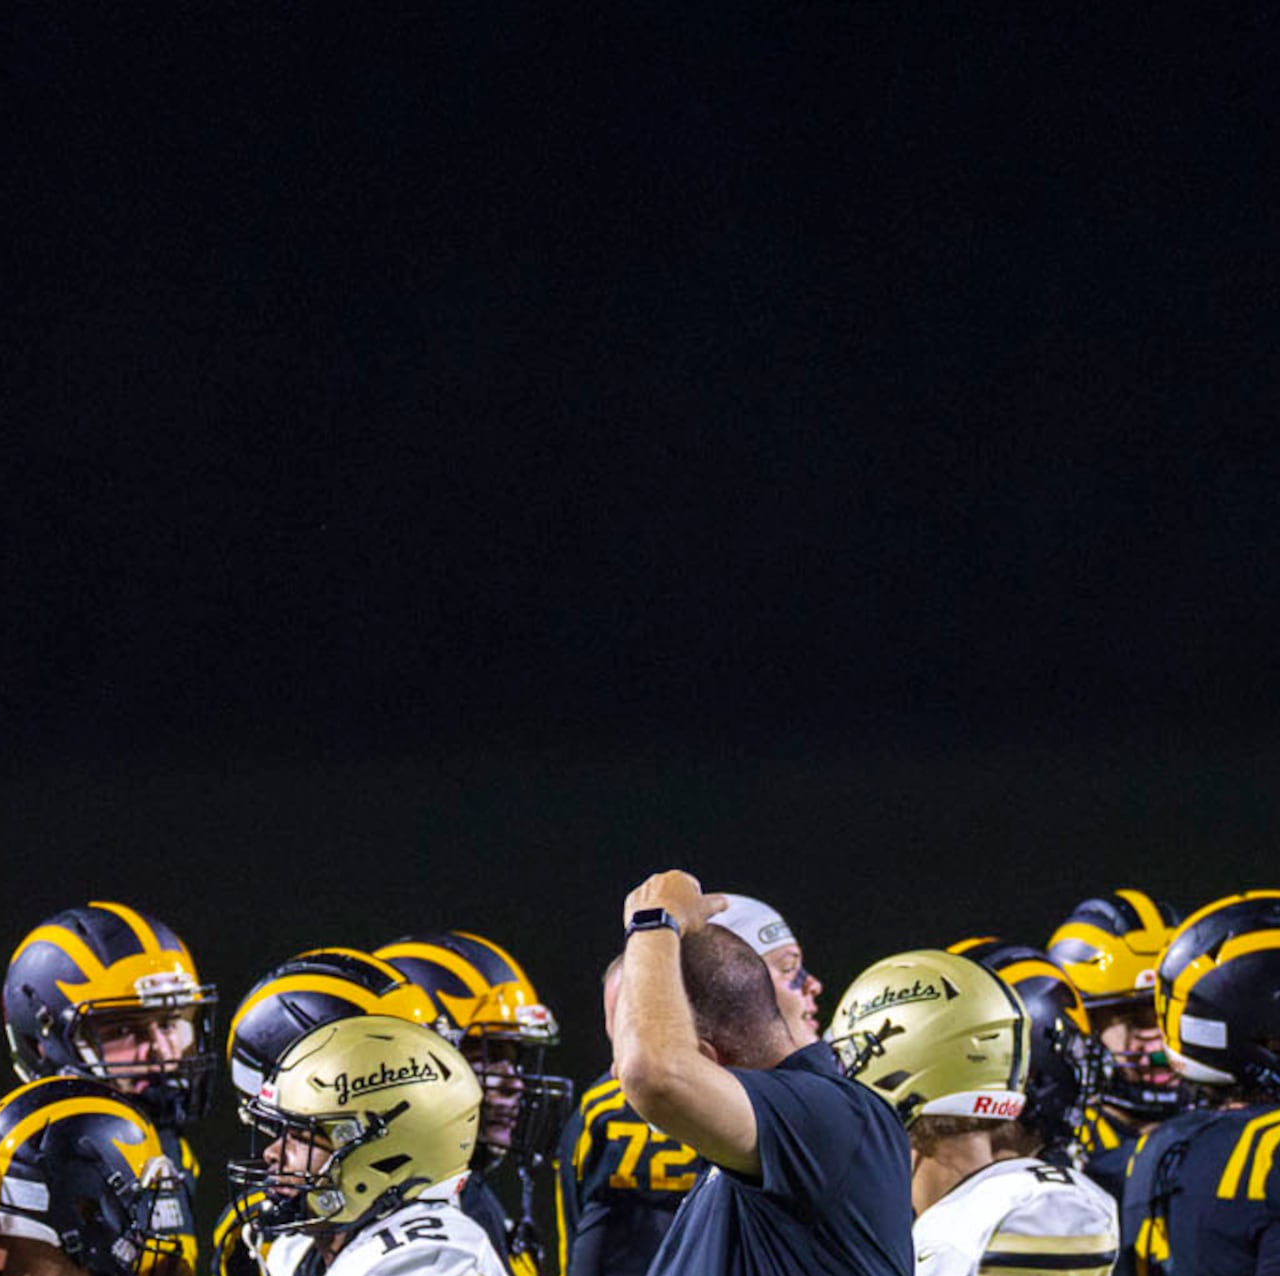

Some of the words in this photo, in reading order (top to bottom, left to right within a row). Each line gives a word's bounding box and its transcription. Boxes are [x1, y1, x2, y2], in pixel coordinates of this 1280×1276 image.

[334, 1058, 438, 1105] Jackets
[606, 1121, 698, 1190] 72
[373, 1215, 449, 1255] 12
